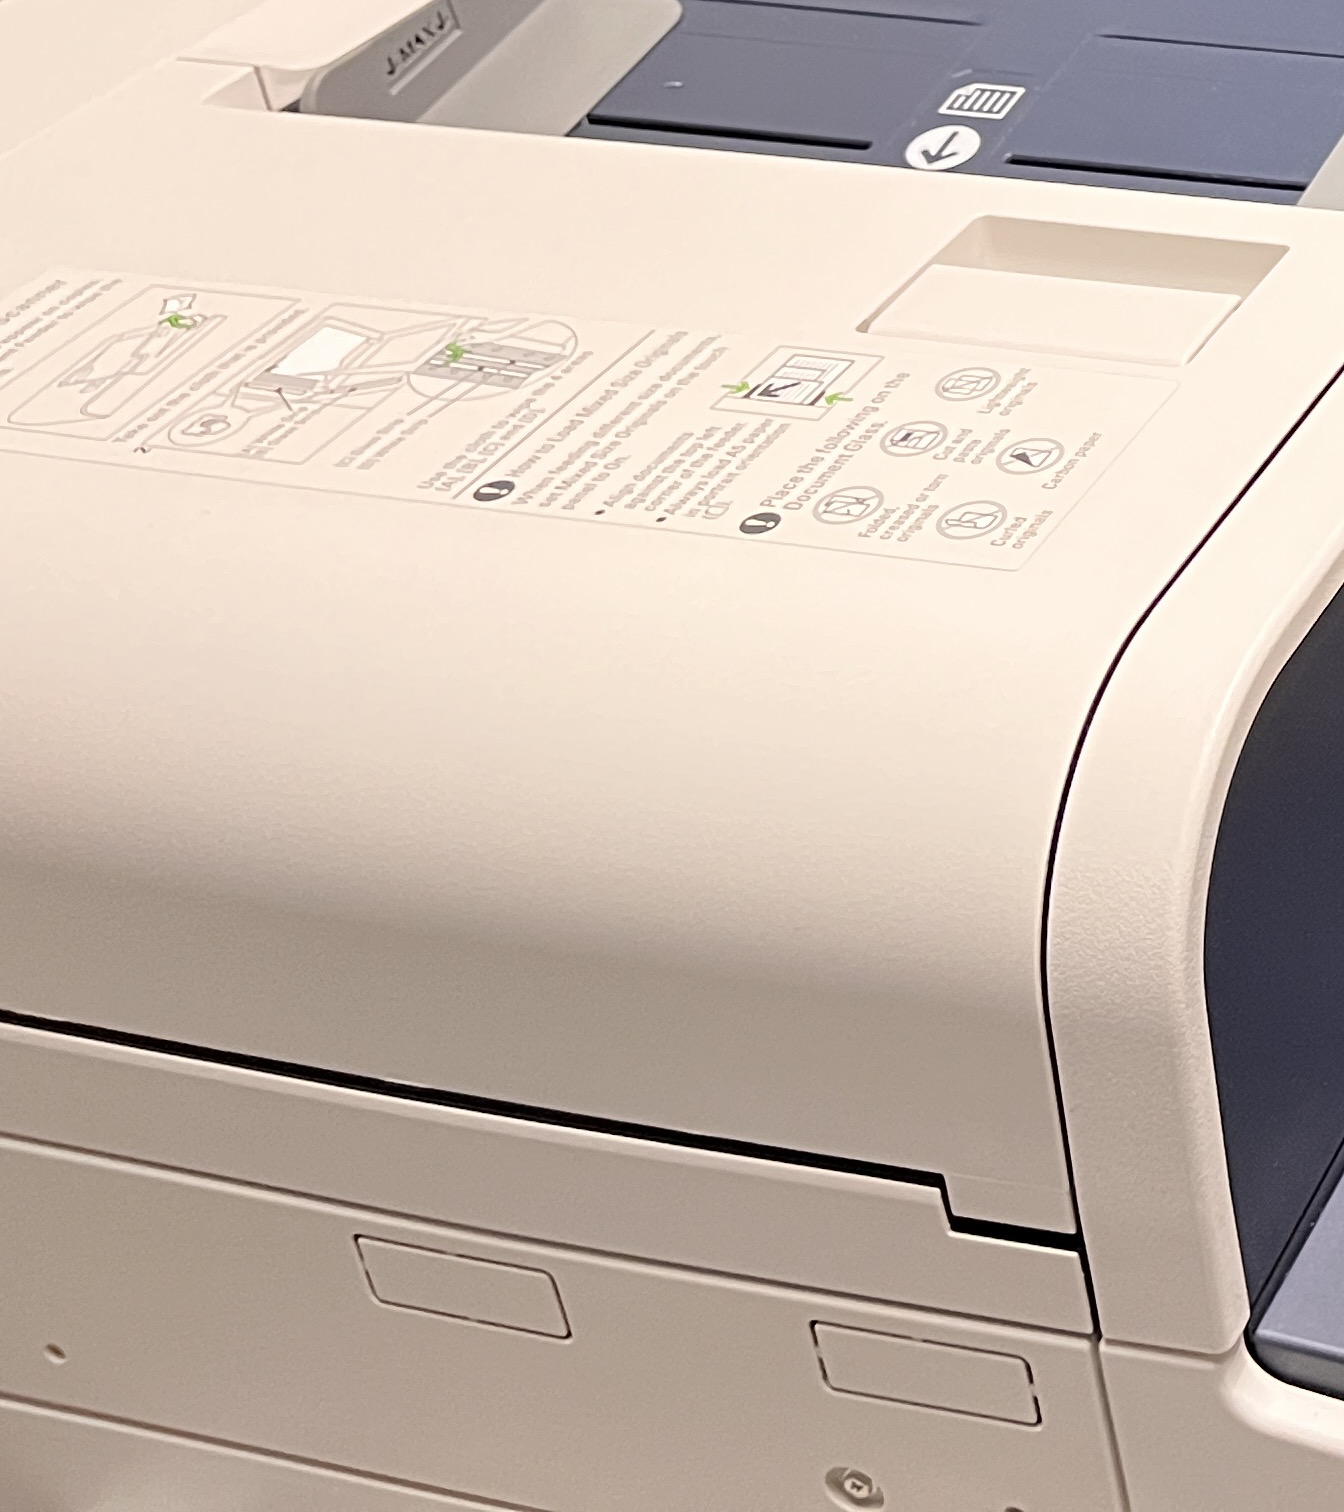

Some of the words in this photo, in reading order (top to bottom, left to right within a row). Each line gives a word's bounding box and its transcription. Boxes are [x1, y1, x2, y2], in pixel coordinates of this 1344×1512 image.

[759, 475, 804, 508] Place
[796, 455, 825, 474] the
[815, 405, 879, 454] following
[870, 390, 891, 404] on
[883, 372, 910, 389] the
[932, 445, 957, 461] Cut
[951, 428, 973, 444] and
[952, 439, 982, 463] paste
[970, 428, 1011, 465] originals
[504, 454, 542, 478] How
[782, 453, 854, 511] Document
[843, 420, 888, 452] Glass.
[1041, 458, 1080, 490] Carbon
[1074, 432, 1102, 458] paper
[857, 506, 900, 538] Folded,
[879, 503, 920, 540] creased
[922, 473, 949, 492] torn
[896, 504, 939, 543] originals
[990, 516, 1027, 547] Curled
[1000, 510, 1053, 550] originals
